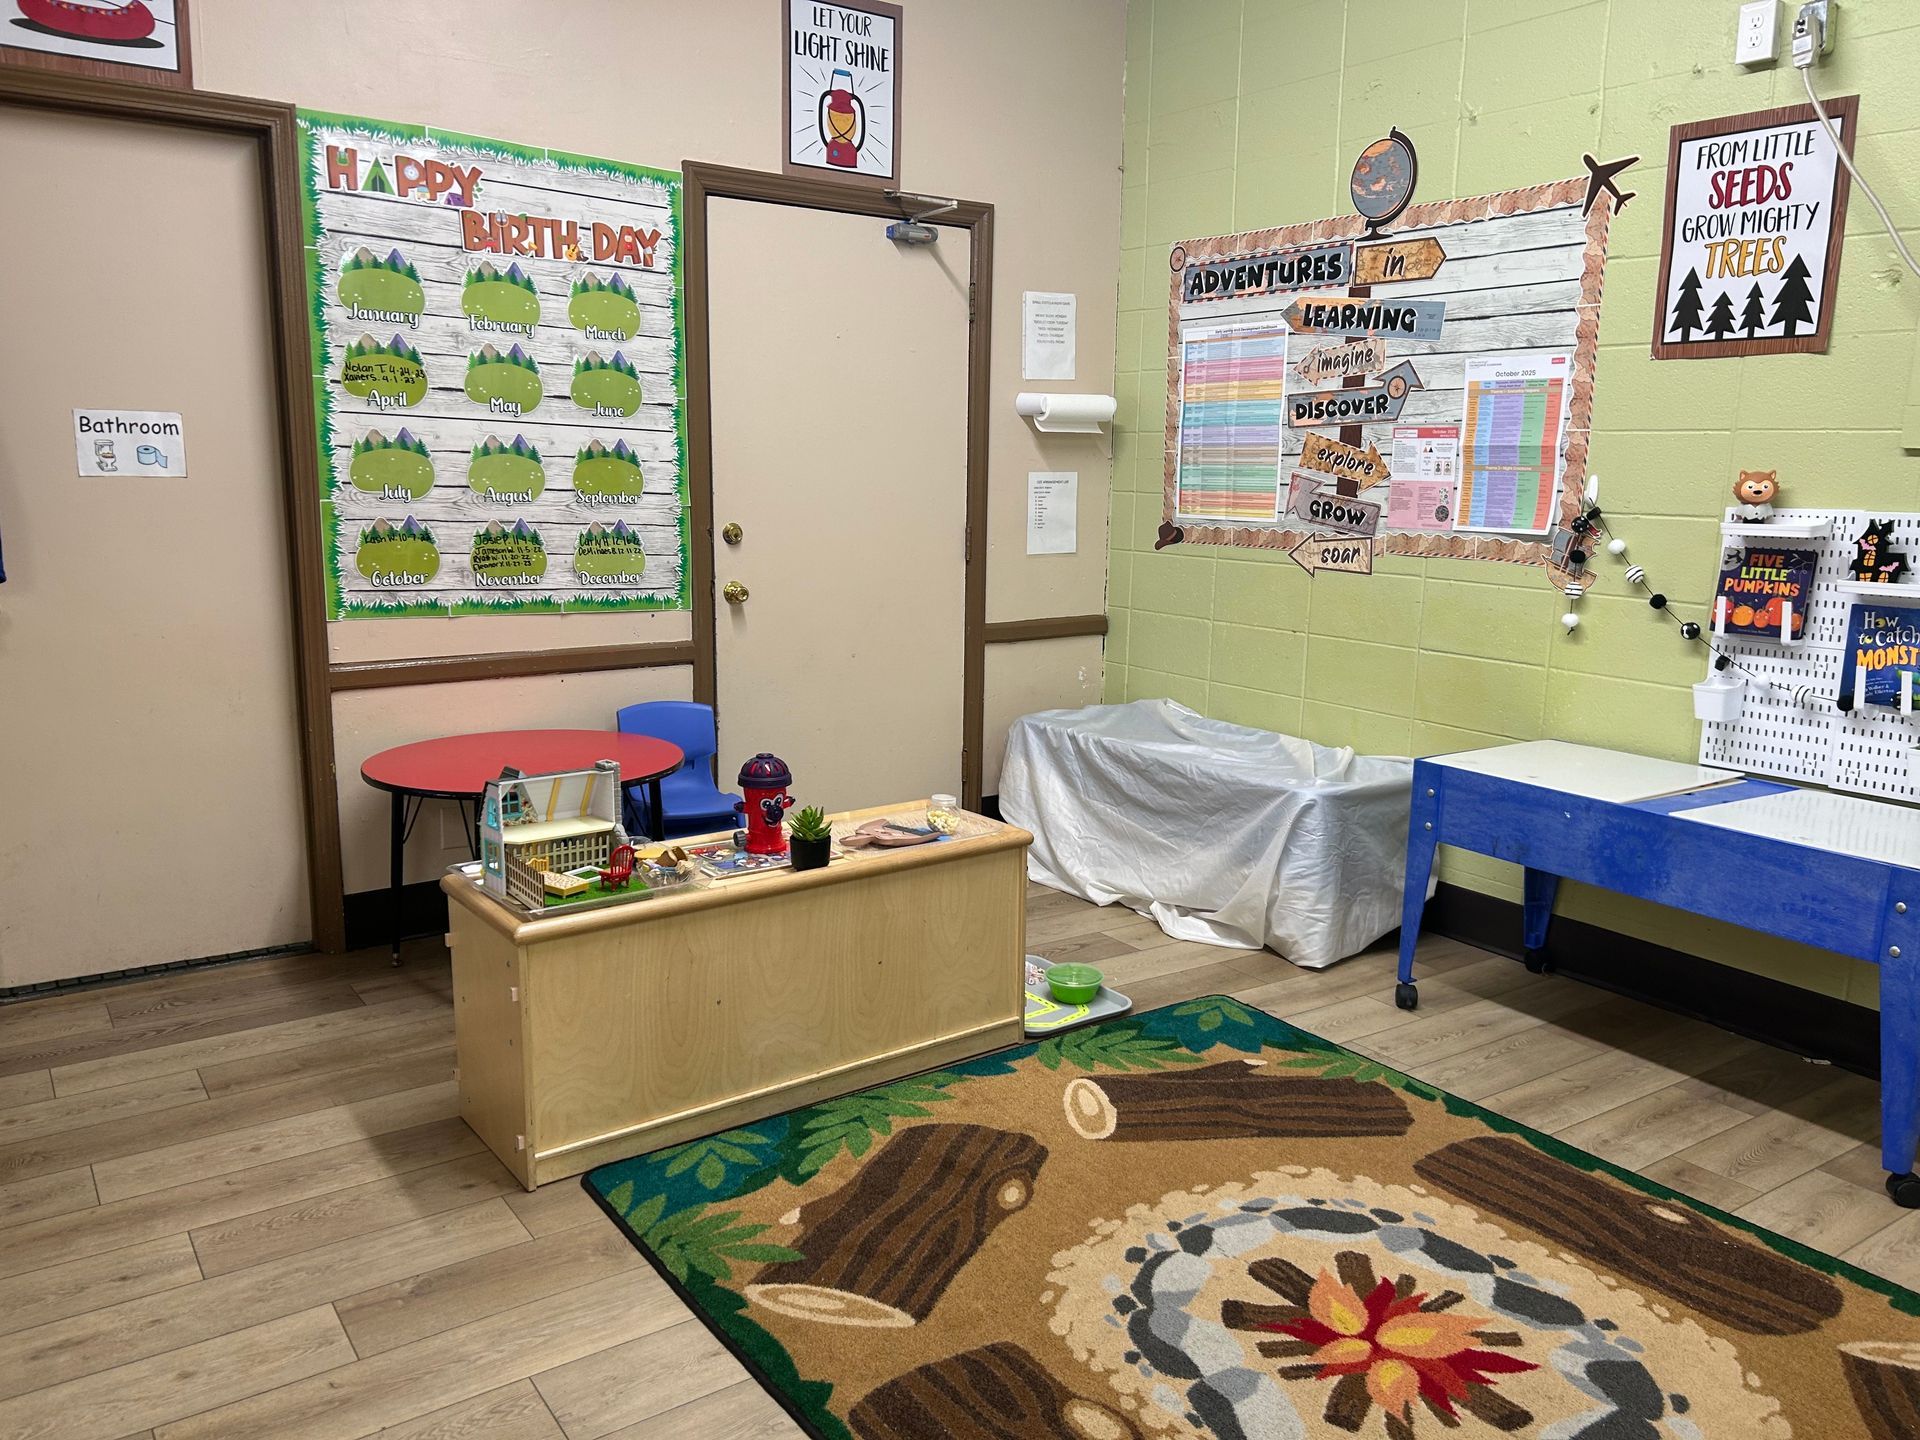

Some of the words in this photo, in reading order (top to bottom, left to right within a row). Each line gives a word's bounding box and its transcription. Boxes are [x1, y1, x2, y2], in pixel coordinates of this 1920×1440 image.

[813, 6, 835, 28] LET
[839, 11, 872, 37] YOUR
[794, 30, 842, 62] LIGHT
[845, 40, 890, 72] SHINE
[1696, 139, 1747, 170] FROM
[1753, 129, 1816, 161] LITTLE
[325, 144, 483, 207] HAPPY
[1708, 161, 1794, 210] SEEDS
[1682, 212, 1736, 243] GROW
[1740, 201, 1820, 236] MIGHTY
[1704, 235, 1787, 279] TREES
[1189, 251, 1344, 296] ADVENTURES
[1382, 247, 1405, 279] in
[349, 302, 420, 329] January
[1302, 303, 1417, 332] LEARNING
[469, 315, 536, 340] February
[585, 325, 627, 341] March
[345, 361, 373, 373] Nolan
[1317, 346, 1375, 377] imagine
[1495, 370, 1520, 378] October
[1521, 369, 1537, 377] 2025
[367, 389, 408, 411] April
[489, 396, 521, 416] May
[592, 402, 624, 418] June
[1295, 393, 1388, 421] DISCOVER
[79, 415, 180, 436] Bathroom
[1317, 447, 1375, 475] explore
[382, 483, 412, 502] July
[483, 486, 533, 505] August
[576, 489, 641, 505] September
[1310, 500, 1366, 526] GROW
[1321, 546, 1361, 564] soar
[1750, 553, 1785, 568] FIVE
[371, 571, 428, 587] October
[475, 572, 544, 587] November
[579, 571, 642, 586] December
[1740, 566, 1788, 581] LITTLE
[1724, 577, 1800, 597] PUMPKINS
[1864, 611, 1899, 629] How
[1858, 633, 1873, 645] to
[1875, 625, 1920, 646] Catch
